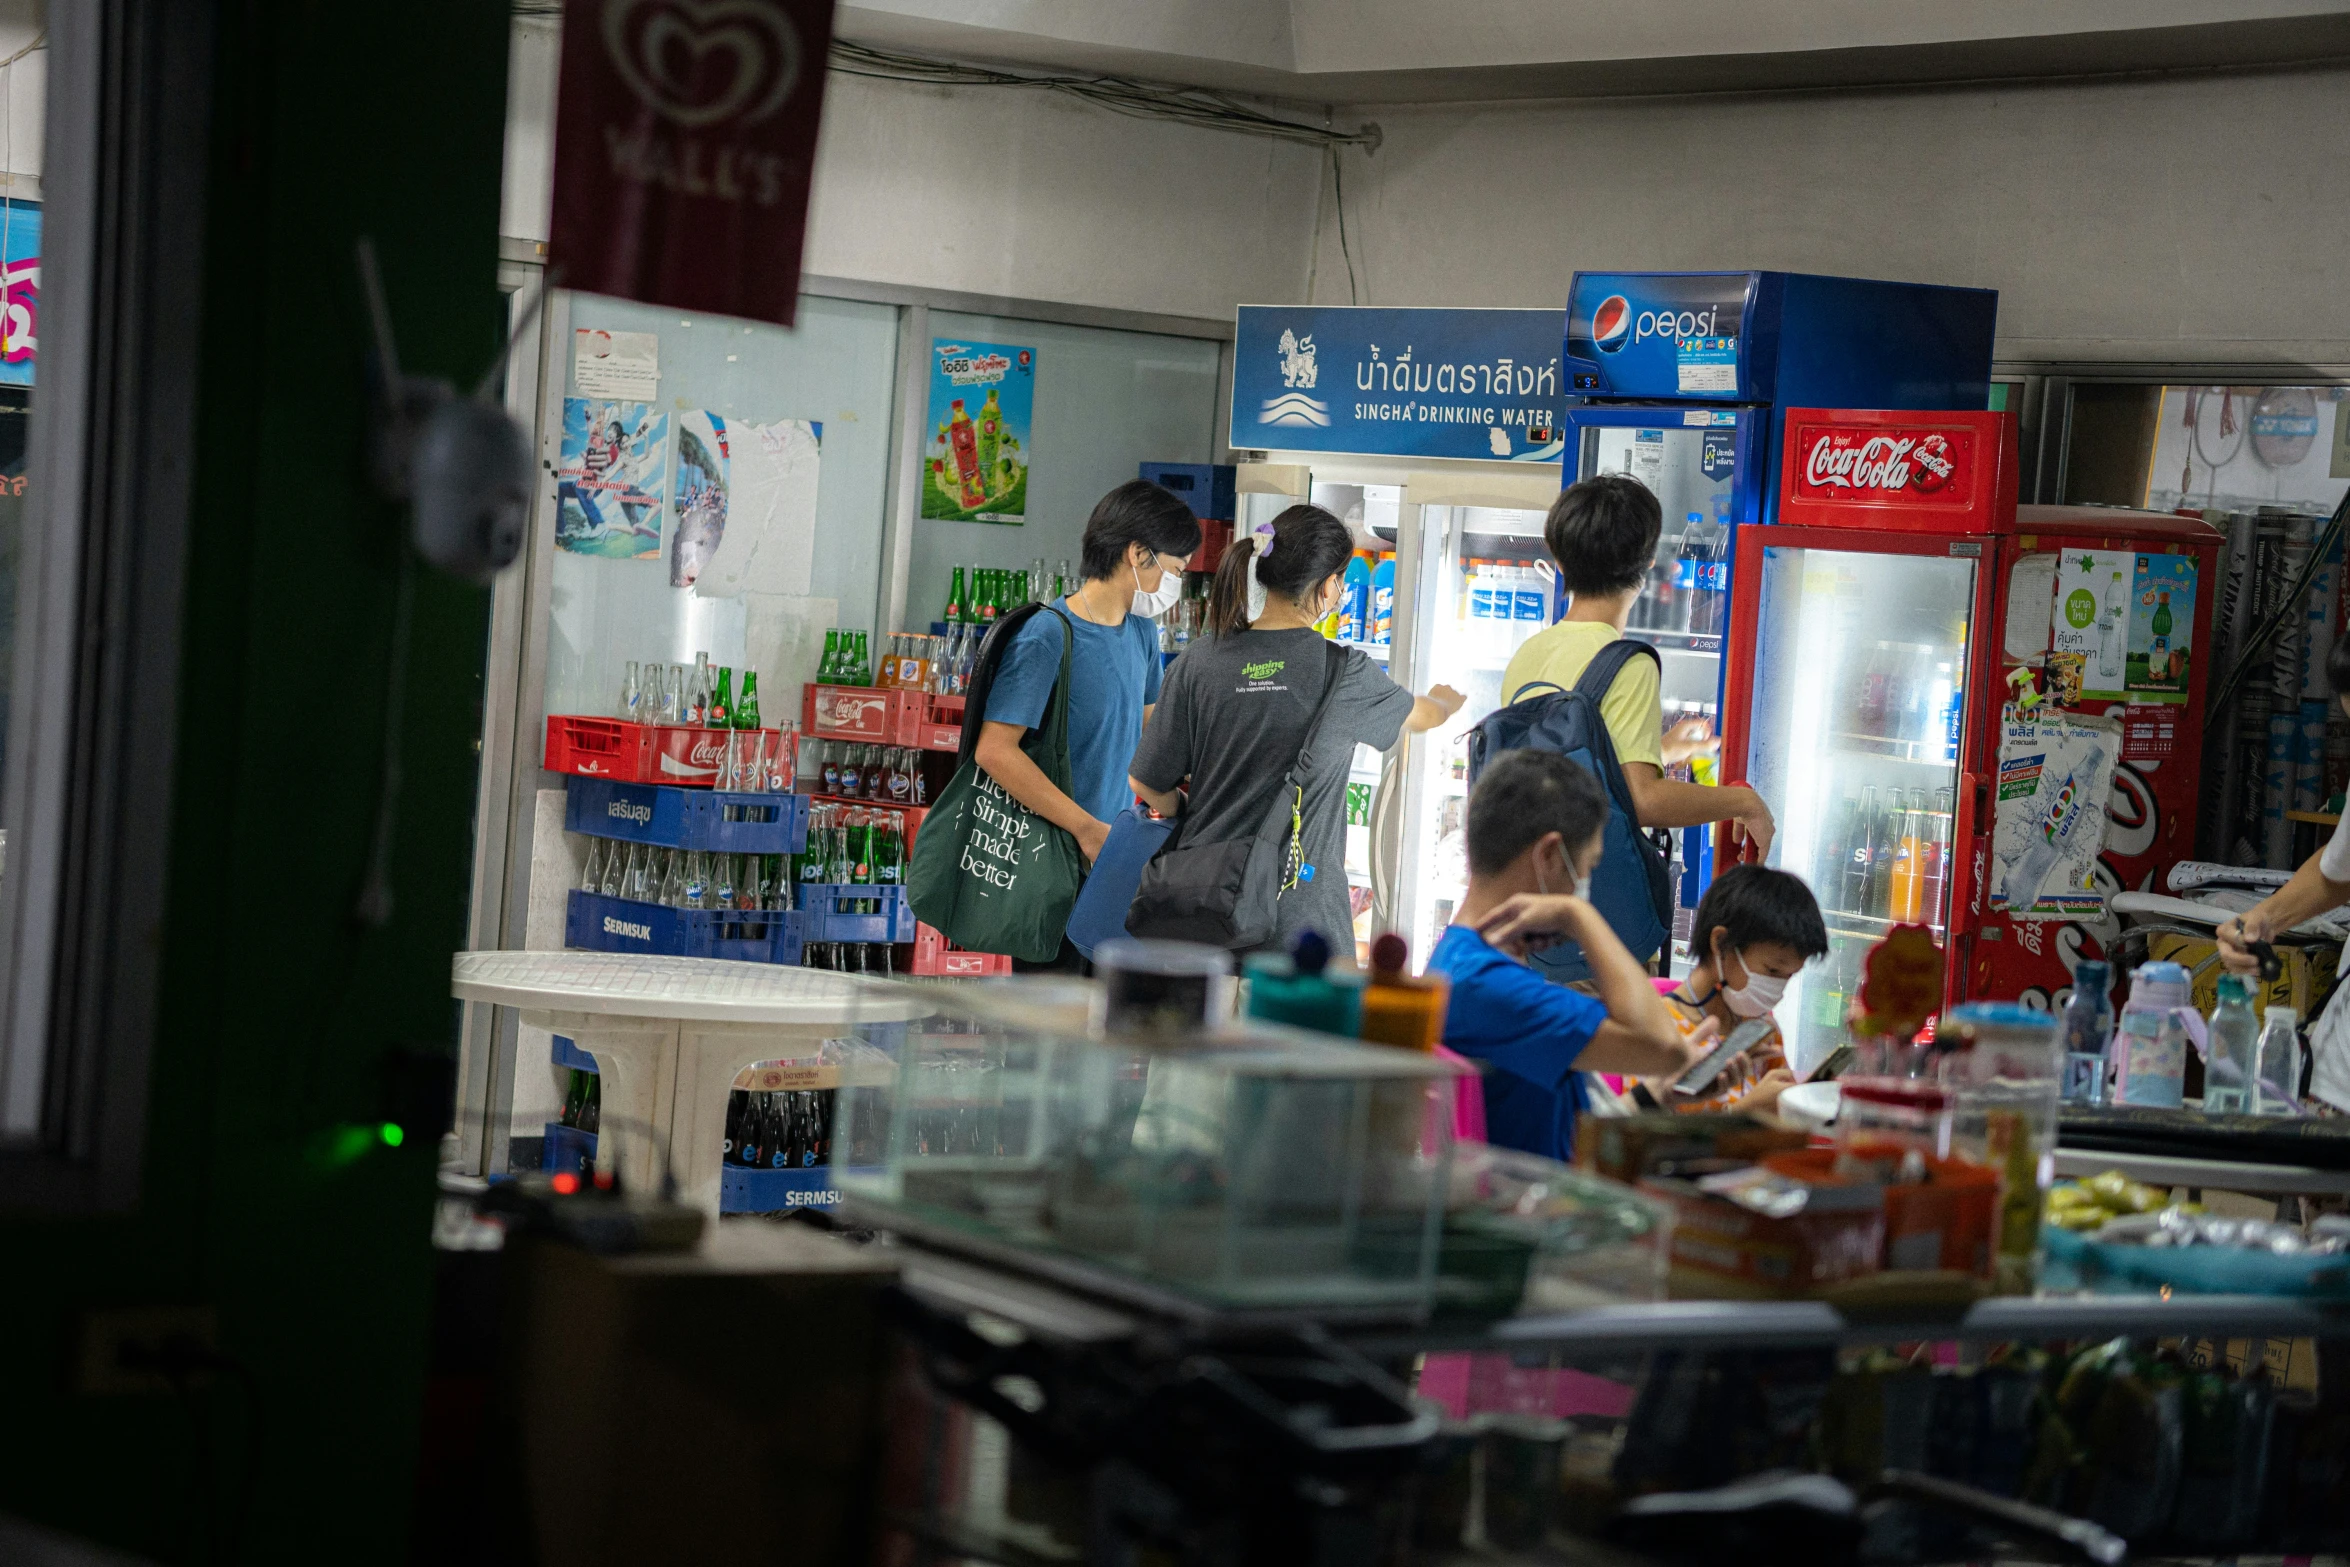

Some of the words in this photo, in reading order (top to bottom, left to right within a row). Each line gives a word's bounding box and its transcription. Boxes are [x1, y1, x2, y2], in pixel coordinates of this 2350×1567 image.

[1635, 304, 1718, 345] pepsi
[1356, 343, 1558, 396] น้ำดื่มตราสิงห์
[1419, 405, 1495, 425] DRINKING
[1502, 408, 1554, 427] WATER
[1834, 435, 1852, 447] Enjoy!
[1807, 435, 1917, 489] Coca-Cola
[1912, 446, 1954, 479] Coca-Cola
[2070, 599, 2091, 609] ขนาด
[1699, 640, 1719, 650] pepsi
[1241, 660, 1285, 675] shipping
[1249, 668, 1278, 679] easy
[2009, 725, 2035, 738] พลัส
[608, 798, 651, 827] เสริมสุข
[972, 795, 1031, 840] Simple
[969, 828, 1021, 865] made
[960, 845, 1017, 891] better
[1971, 849, 1985, 917] Coca-Cola
[603, 915, 651, 941] SERMSUK
[784, 1189, 845, 1207] SERMSU
